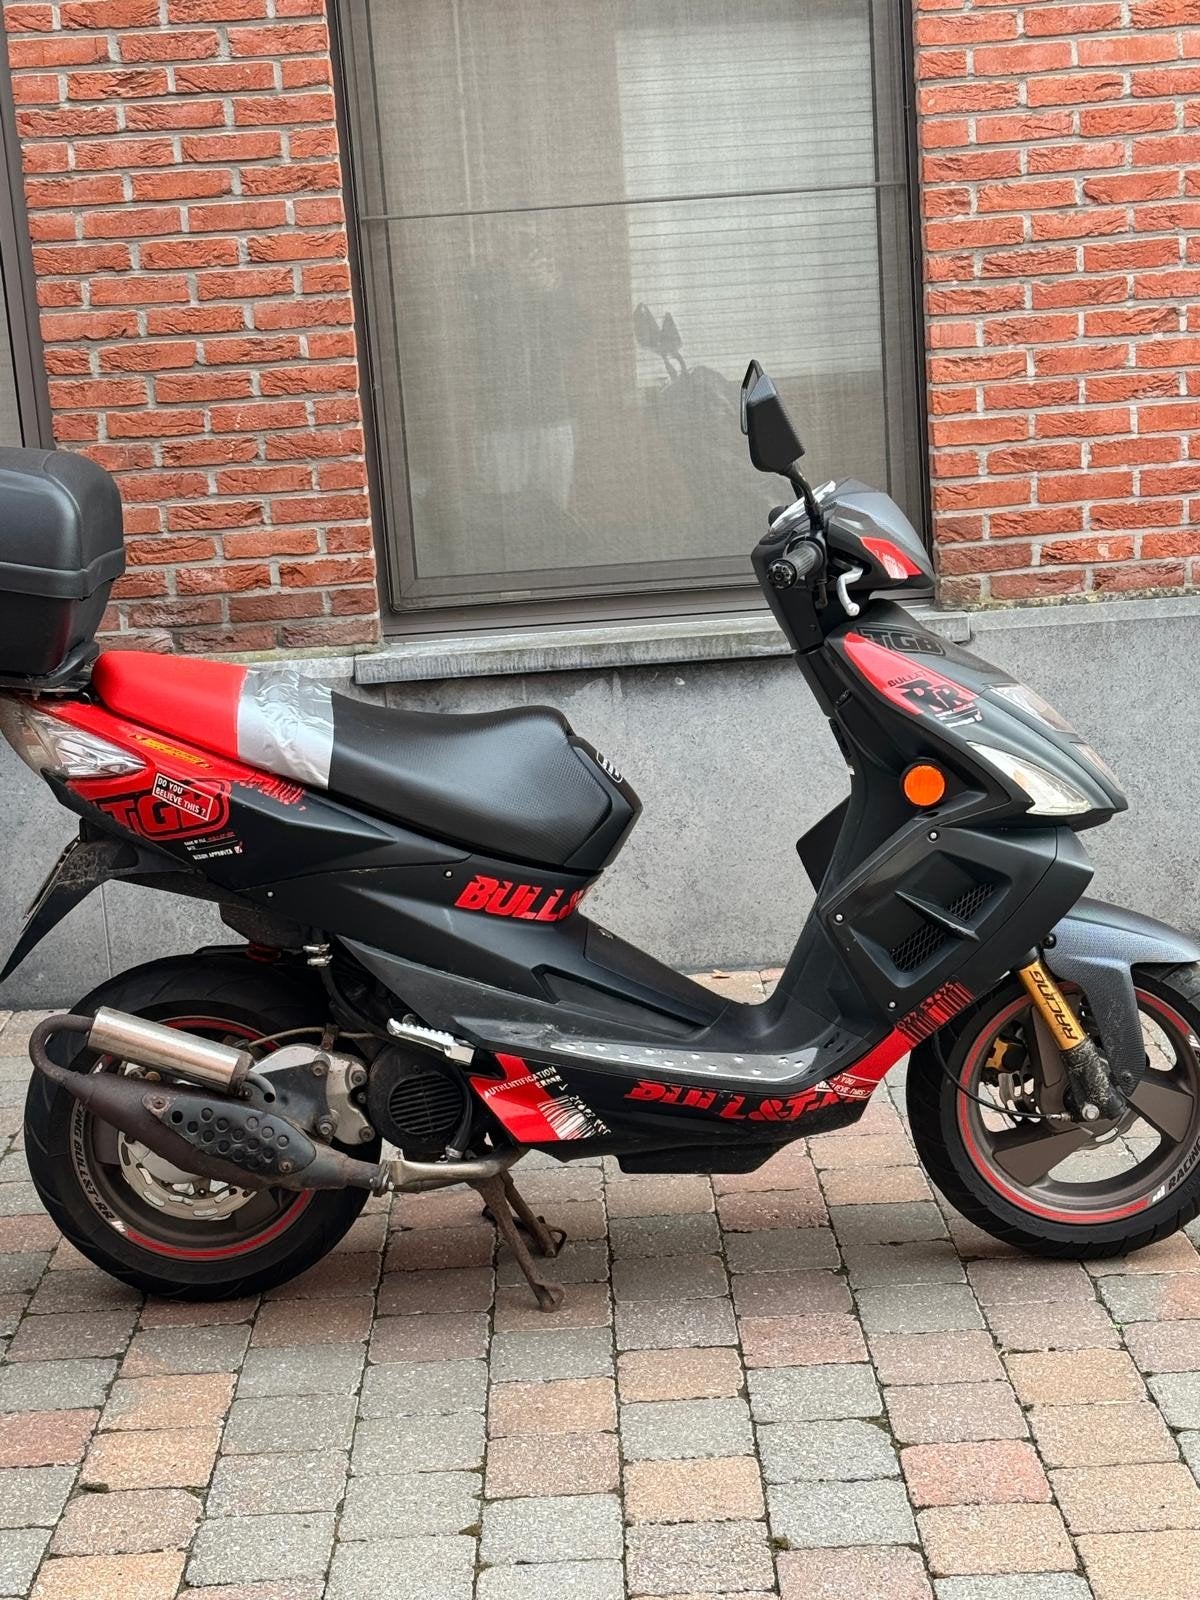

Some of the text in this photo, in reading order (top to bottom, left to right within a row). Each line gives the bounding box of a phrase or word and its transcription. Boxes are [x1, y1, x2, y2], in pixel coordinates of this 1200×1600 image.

[858, 627, 945, 656] TGB
[157, 777, 183, 794] DO YOU
[155, 787, 182, 805] BELIEVE
[184, 800, 200, 813] THIS
[1029, 969, 1078, 1040] RACING
[483, 1066, 557, 1099] AUTHENTIFICATION
[535, 1075, 563, 1089] ERROR
[840, 1076, 856, 1085] YOU
